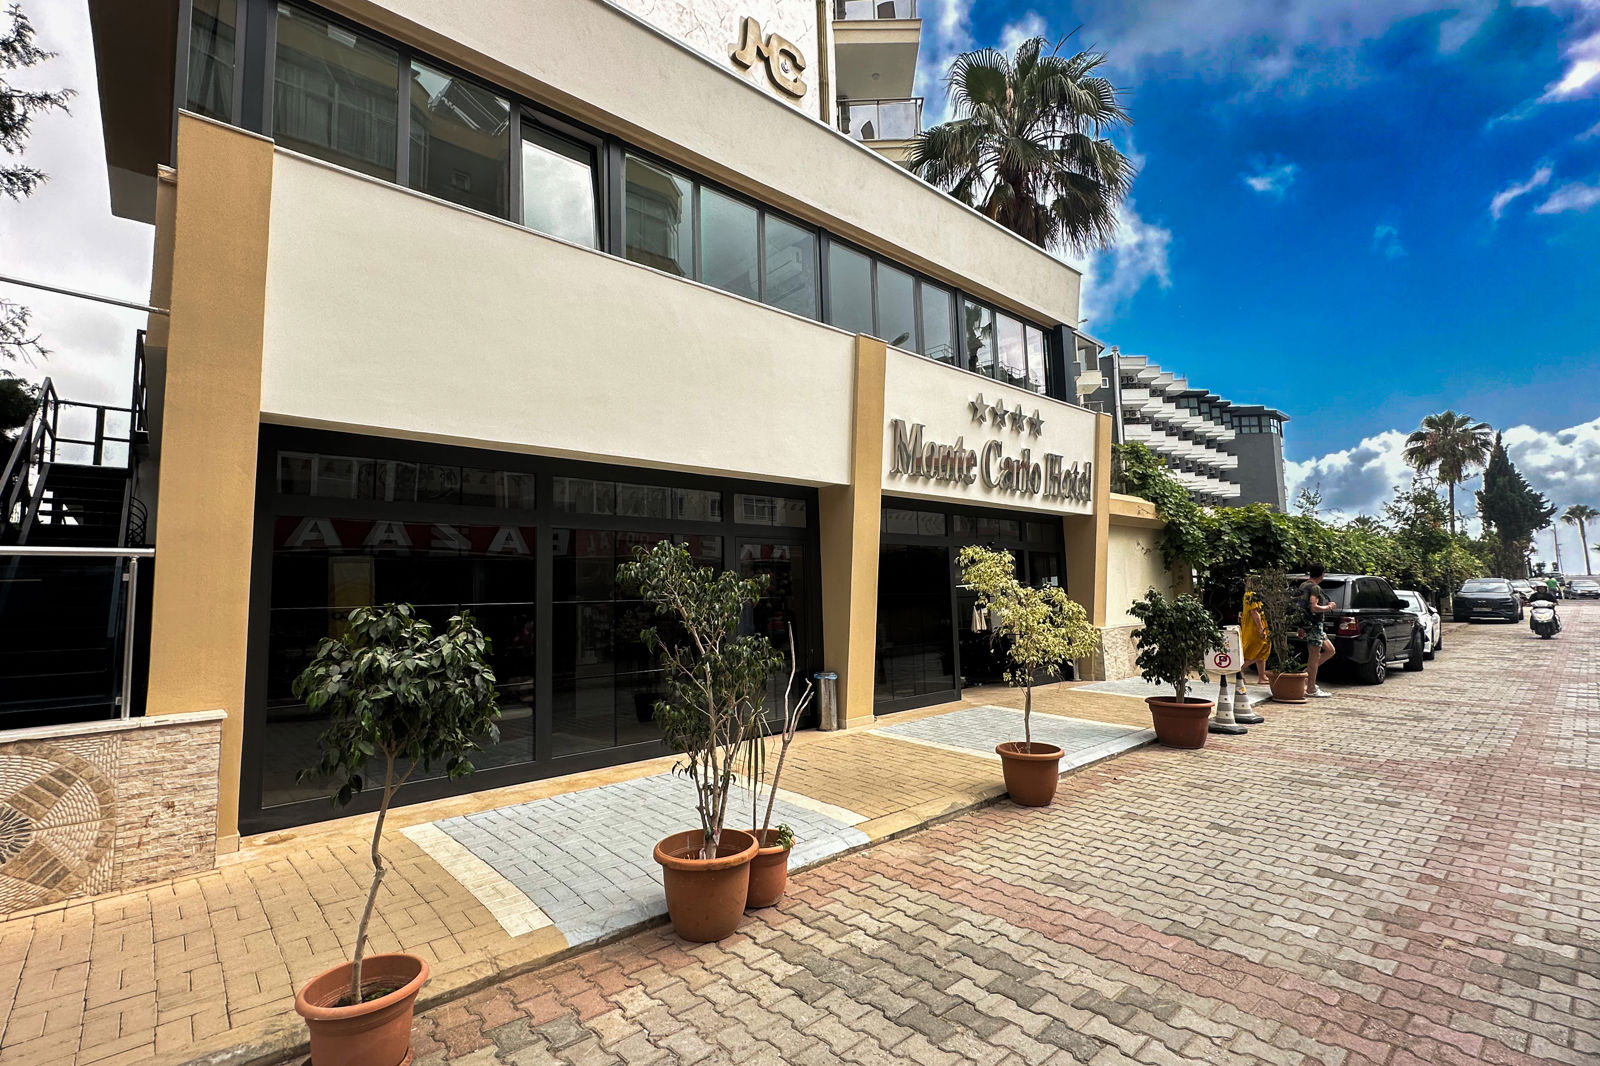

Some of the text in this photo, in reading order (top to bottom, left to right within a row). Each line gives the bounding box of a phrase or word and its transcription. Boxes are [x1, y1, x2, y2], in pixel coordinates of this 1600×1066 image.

[889, 418, 1092, 501] Monte Carlo Hotel
